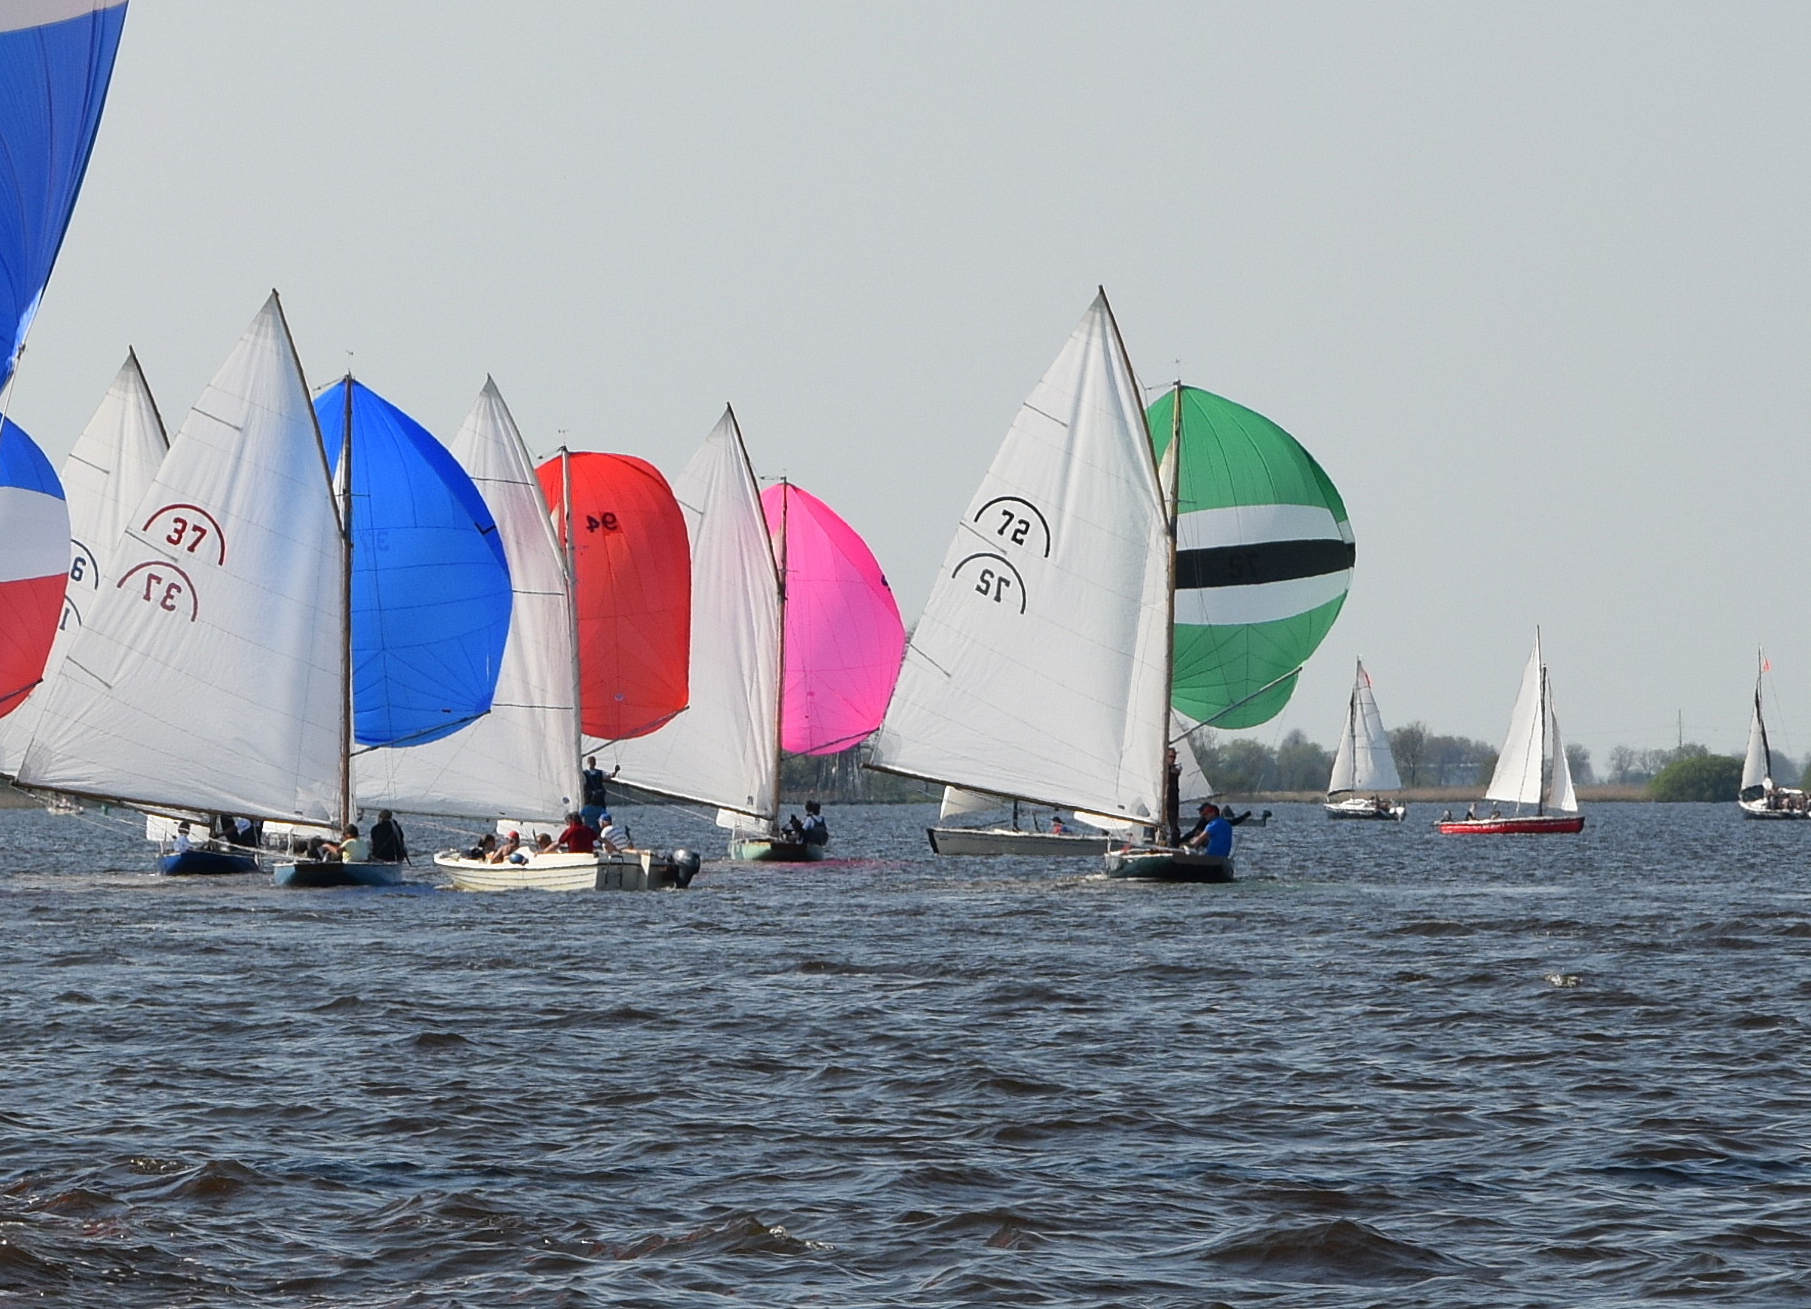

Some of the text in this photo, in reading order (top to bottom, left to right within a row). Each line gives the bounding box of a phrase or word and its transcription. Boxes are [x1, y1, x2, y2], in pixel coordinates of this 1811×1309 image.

[166, 517, 207, 553] 37
[997, 509, 1030, 546] 72
[71, 556, 86, 581] 6
